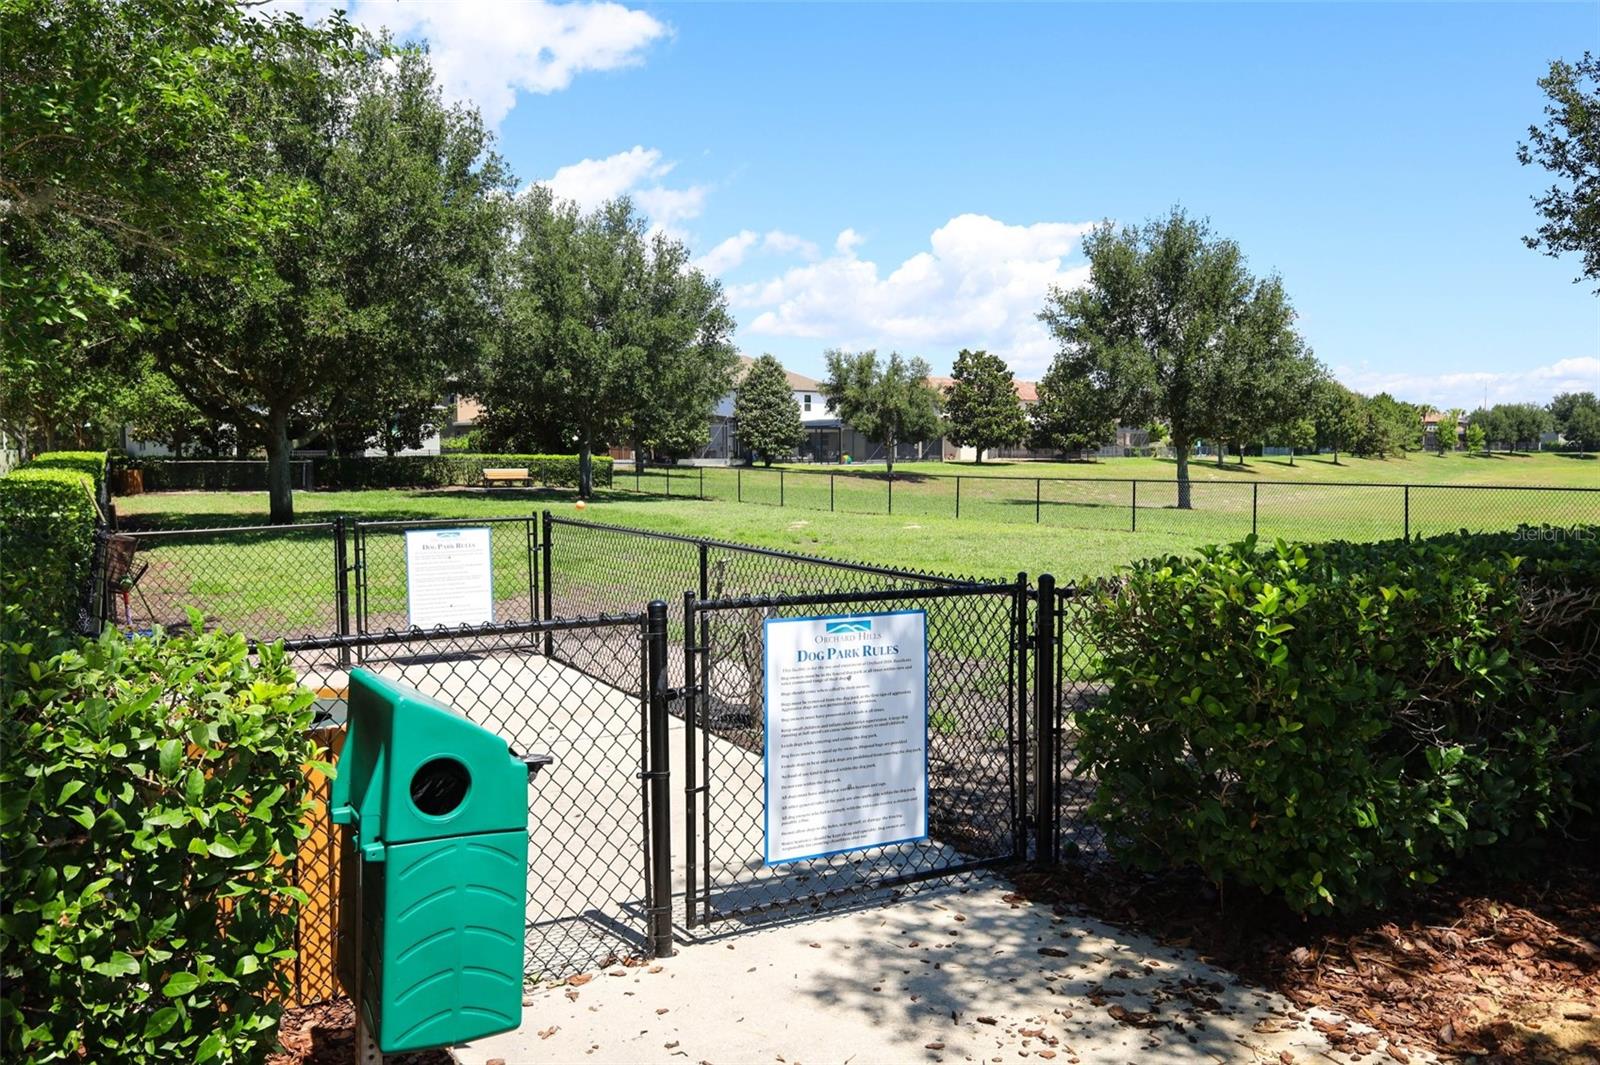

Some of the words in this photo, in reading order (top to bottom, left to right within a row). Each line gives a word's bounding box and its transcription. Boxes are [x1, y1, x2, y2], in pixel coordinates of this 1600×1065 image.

[814, 632, 856, 644] ORCHARD
[858, 631, 882, 641] HILLS
[797, 650, 825, 662] DOG
[827, 647, 861, 660] PARK
[862, 644, 899, 657] RULES
